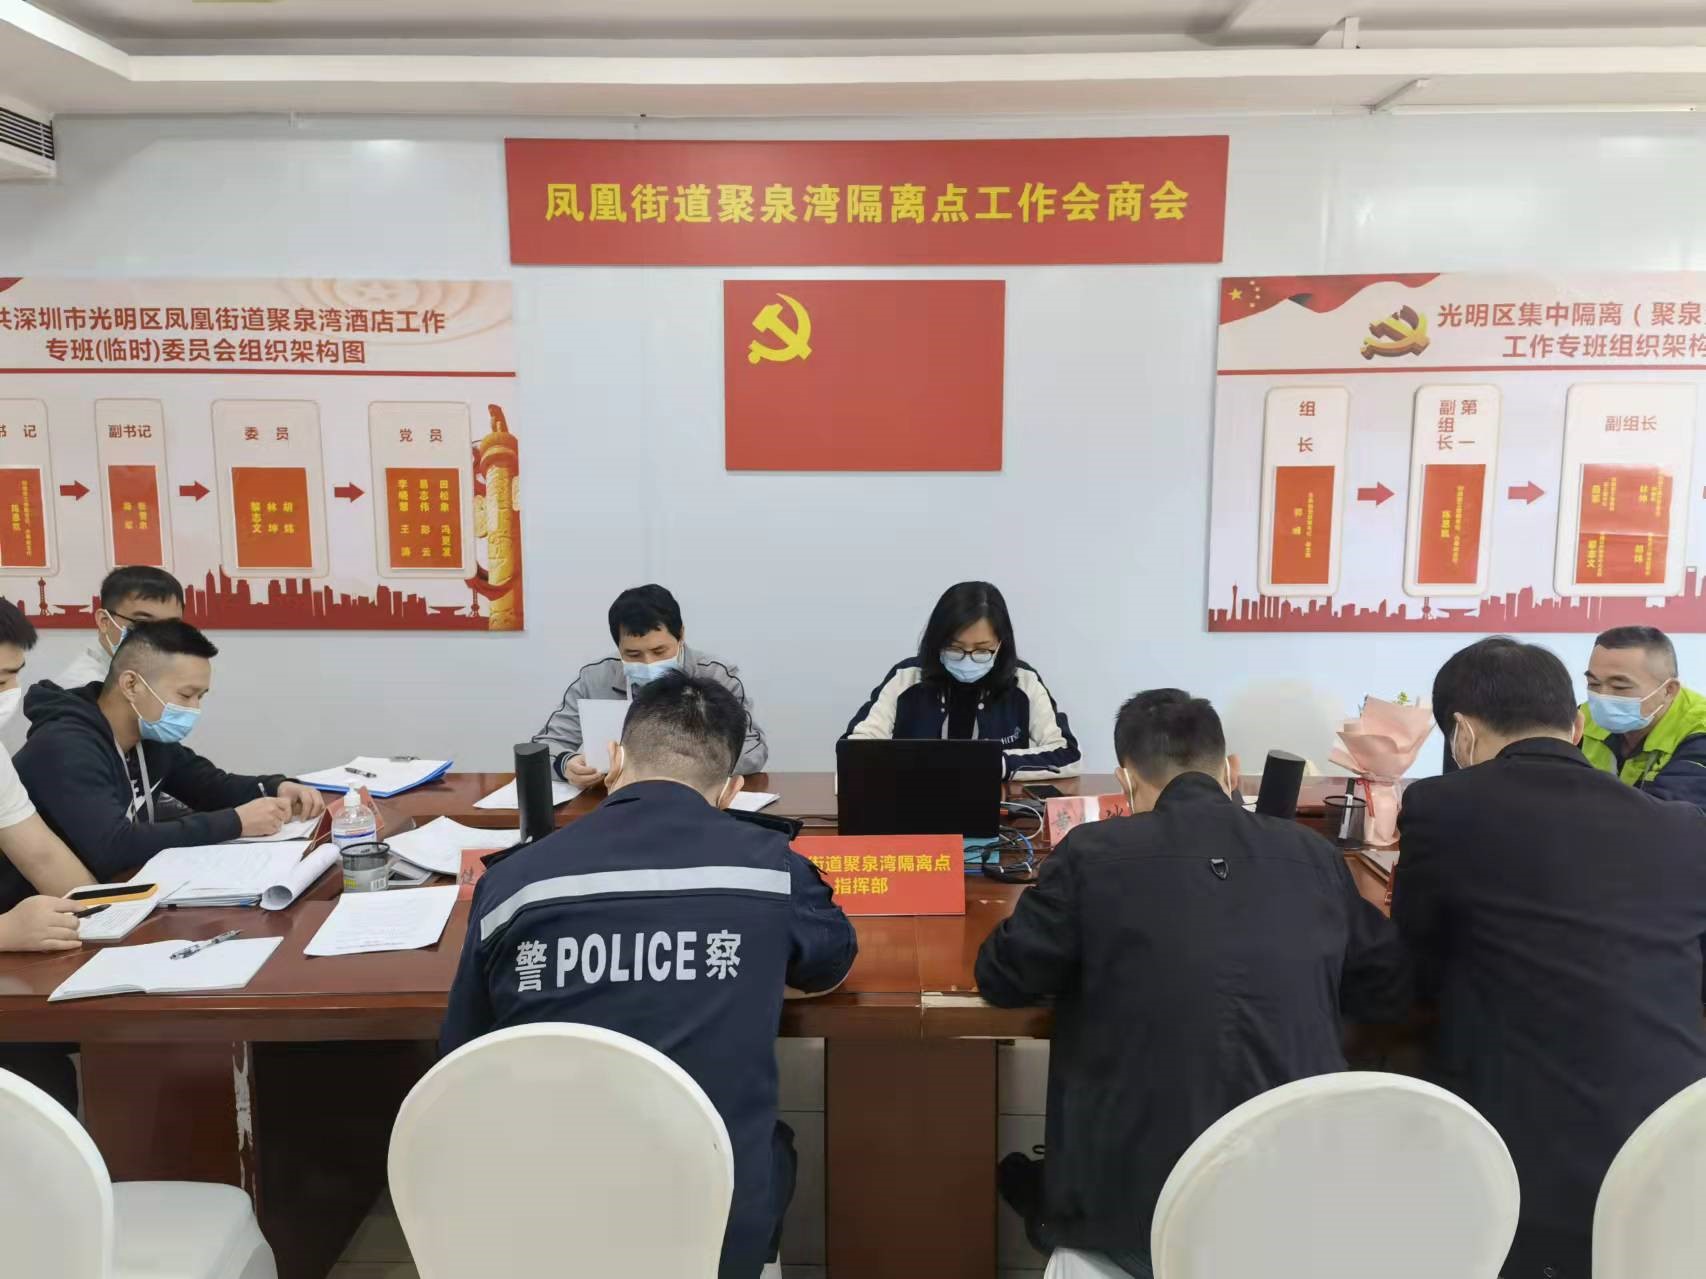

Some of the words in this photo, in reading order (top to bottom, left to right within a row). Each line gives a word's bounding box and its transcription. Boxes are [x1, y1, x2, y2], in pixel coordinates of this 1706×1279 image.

[544, 179, 1190, 226] 凤凰街道聚泉湾隔离点工作会商会
[45, 337, 367, 365] 专班(临时)委员会组织架构图
[107, 423, 153, 439] 副书记
[1604, 415, 1658, 433] 副组长
[834, 876, 890, 895] 指挥部
[515, 940, 548, 992] 警
[556, 930, 698, 988] POLICE
[705, 929, 742, 980] 察
